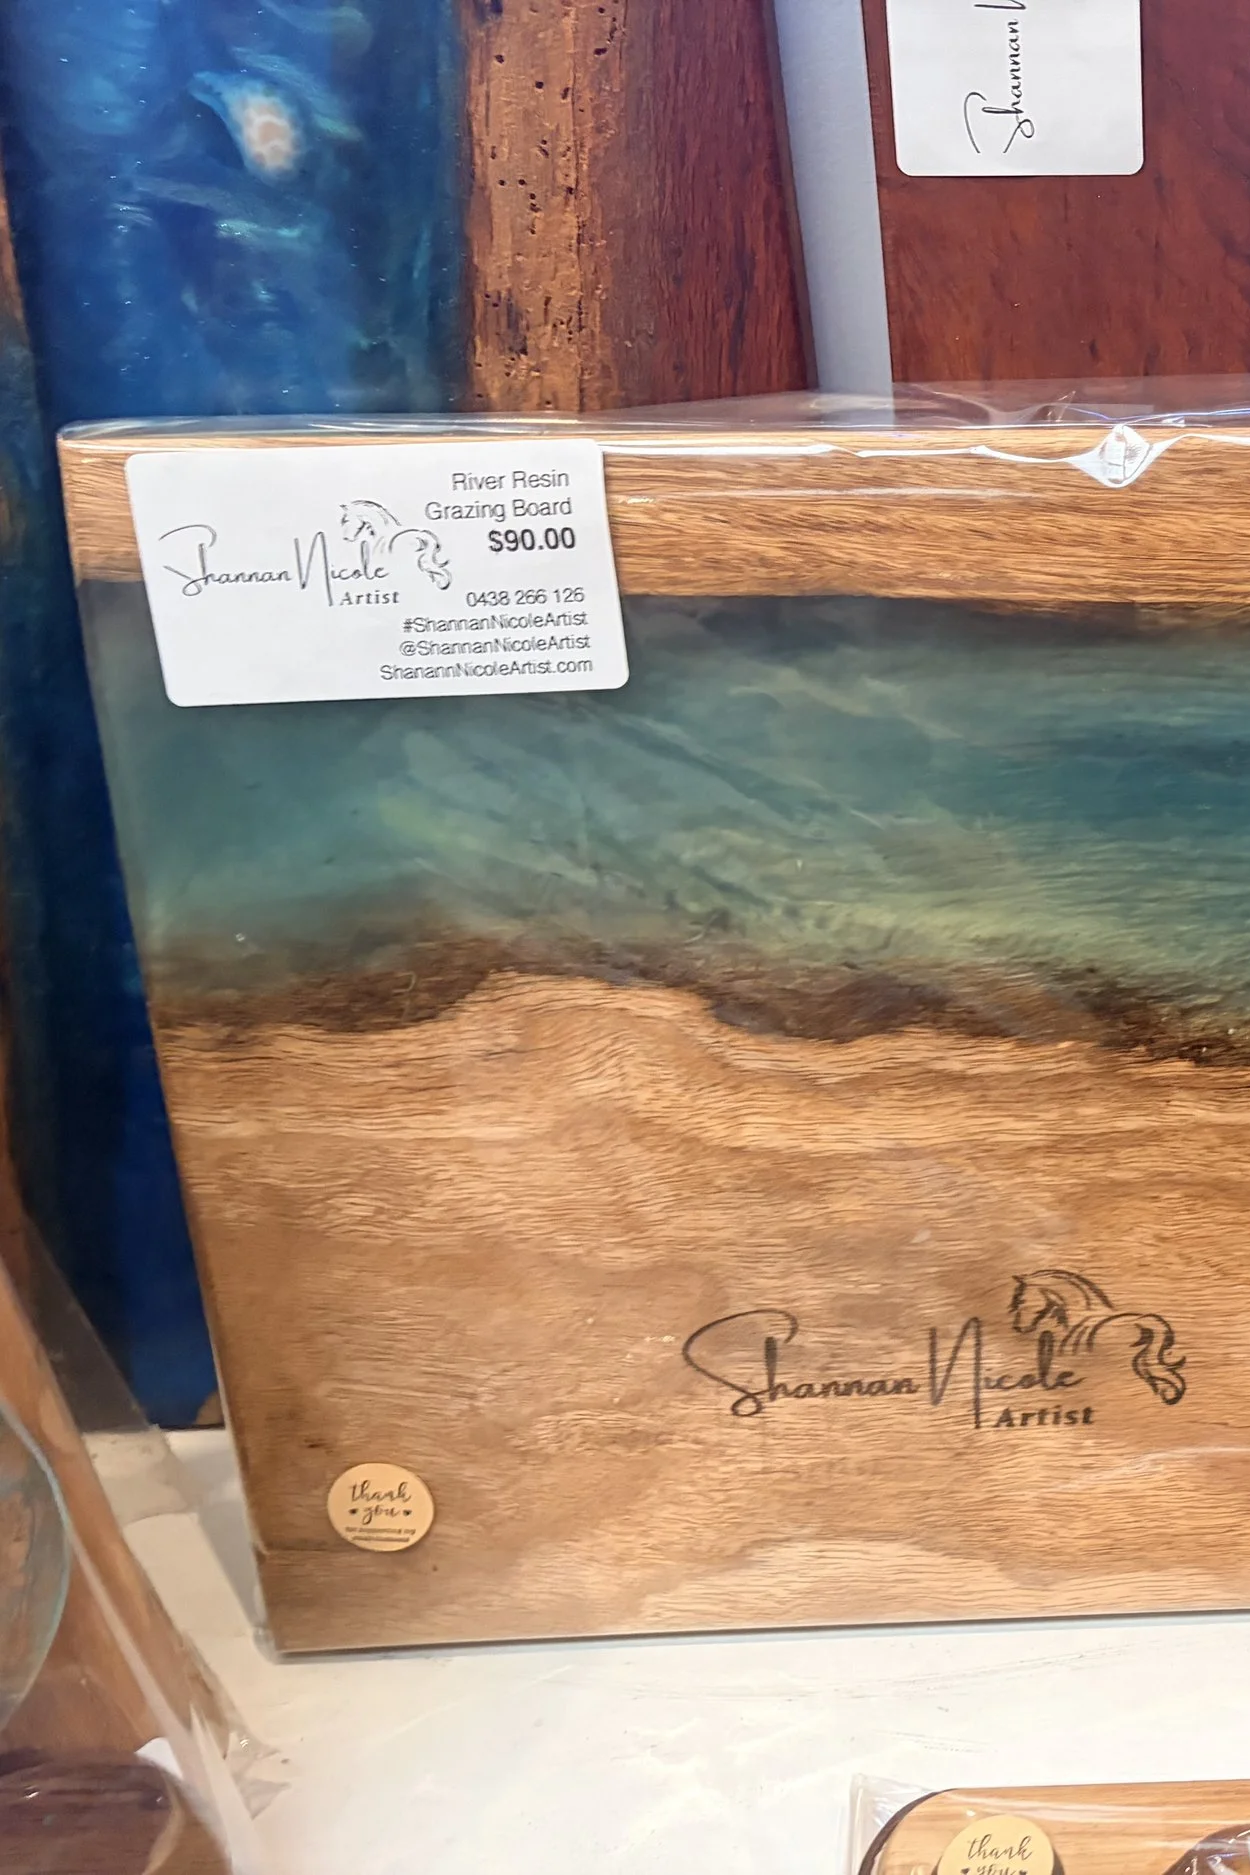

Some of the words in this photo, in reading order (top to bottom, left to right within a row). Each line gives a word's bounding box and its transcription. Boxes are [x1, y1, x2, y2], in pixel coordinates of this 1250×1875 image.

[964, 19, 1035, 153] Shannan
[452, 472, 506, 491] River
[512, 469, 570, 488] Resin
[425, 500, 506, 522] Grazing
[512, 497, 572, 517] Board
[488, 527, 575, 554] $90.00
[158, 524, 292, 597] Shannan
[293, 531, 390, 606] Nicole
[339, 590, 400, 606] Artist
[466, 591, 511, 607] 0438
[514, 588, 548, 605] 266
[552, 587, 585, 603] 126
[403, 611, 588, 633] #ShannanNicoleArtist
[400, 634, 591, 656] @ShannanNicoleArtist
[683, 1308, 919, 1417] Shannan
[928, 1316, 1086, 1429] Nicole
[997, 1405, 1095, 1429] Artist
[350, 1480, 412, 1502] thank
[361, 1504, 400, 1525] you
[967, 1833, 1033, 1861] thank
